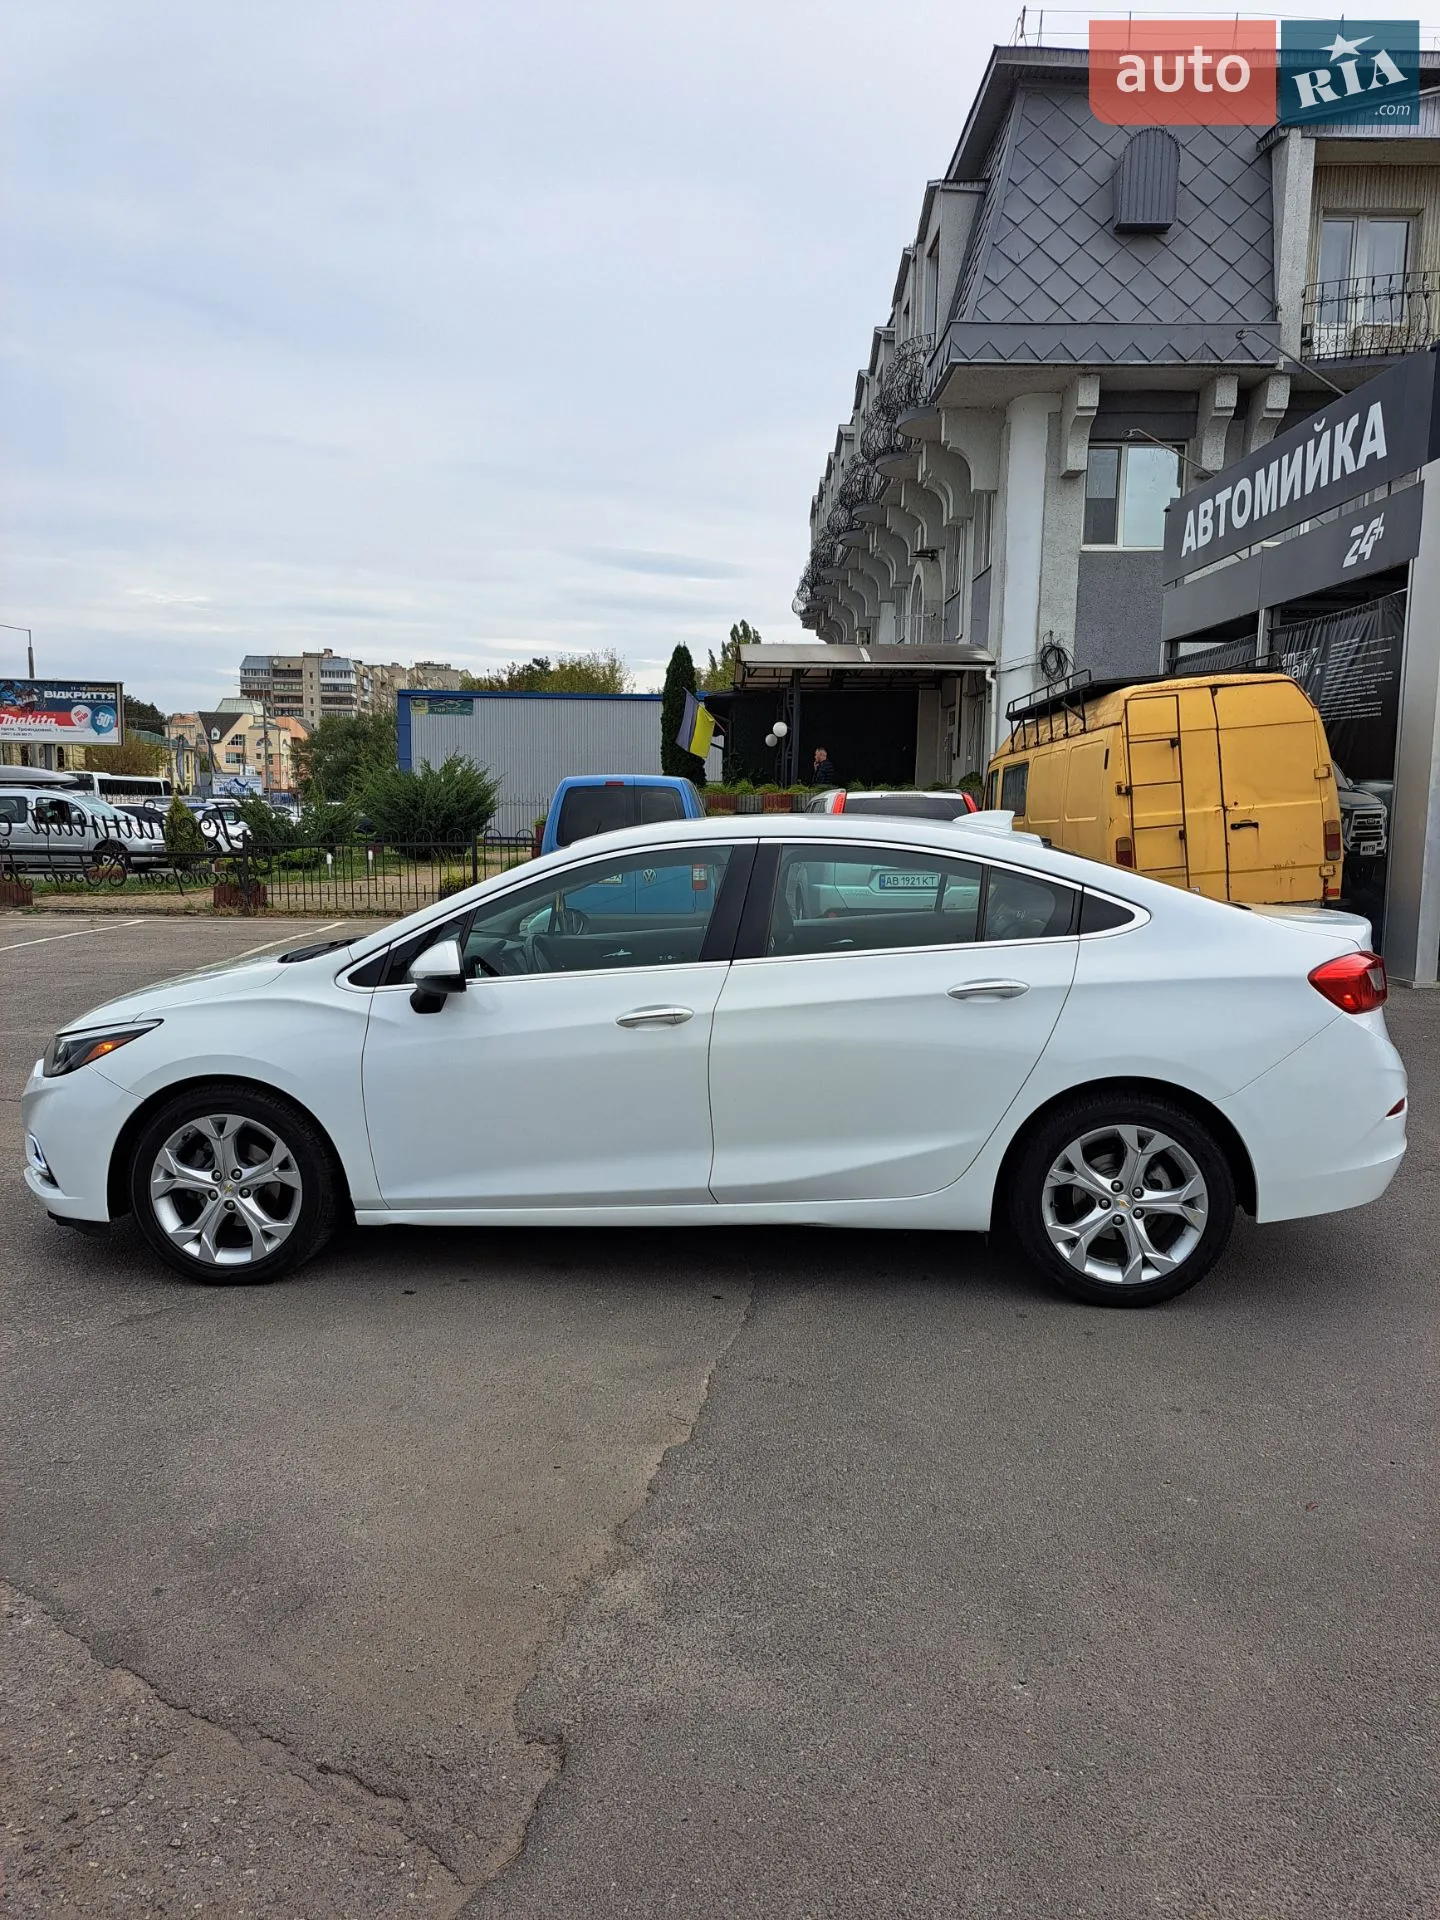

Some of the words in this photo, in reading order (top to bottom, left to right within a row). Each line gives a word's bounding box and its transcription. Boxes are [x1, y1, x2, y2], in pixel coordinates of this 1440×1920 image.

[1181, 401, 1388, 558] АВТОМИЙКА
[44, 690, 116, 700] ВІДКРИТТЯ
[886, 877, 899, 885] AB
[901, 877, 921, 885] 1921
[922, 877, 936, 885] KT
